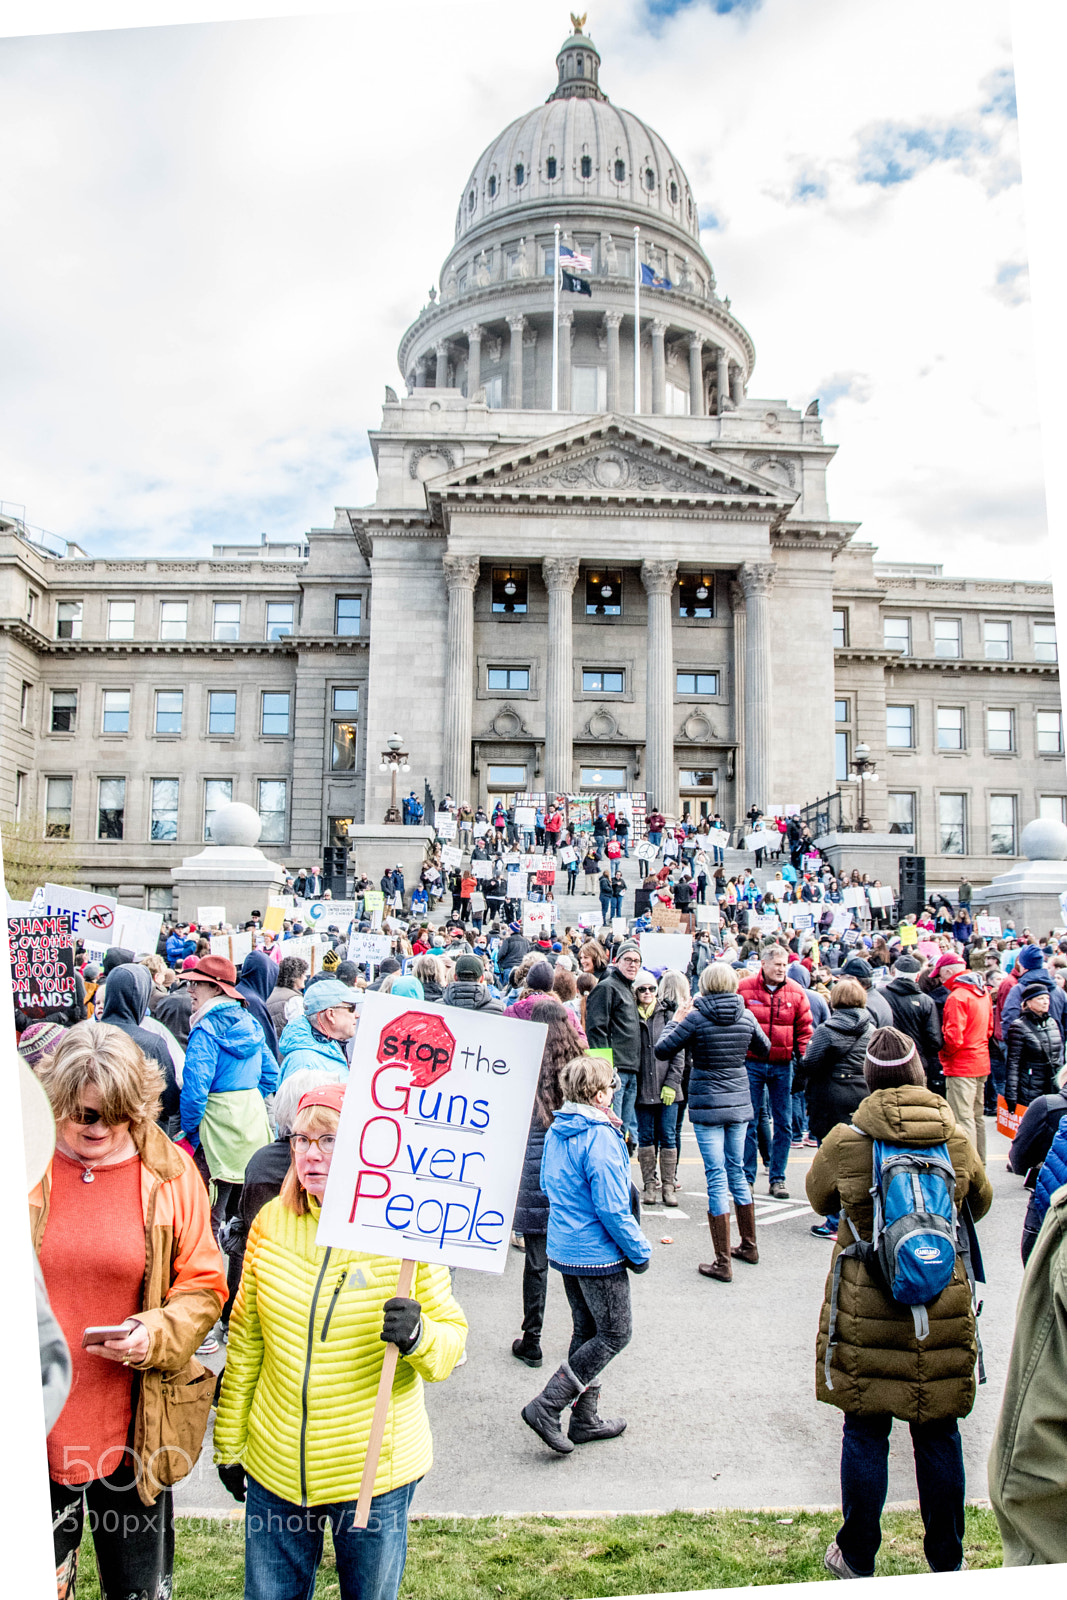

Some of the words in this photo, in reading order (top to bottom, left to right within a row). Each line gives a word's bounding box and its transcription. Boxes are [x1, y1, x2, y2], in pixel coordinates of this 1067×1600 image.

[8, 917, 70, 936] SHAME
[32, 949, 59, 962] 1313
[36, 977, 76, 993] YOUR
[18, 993, 74, 1008] HANDS
[383, 1034, 450, 1072] stop
[460, 1045, 511, 1075] the
[371, 1062, 490, 1128] Guns
[359, 1116, 486, 1182] Over
[348, 1170, 505, 1249] People
